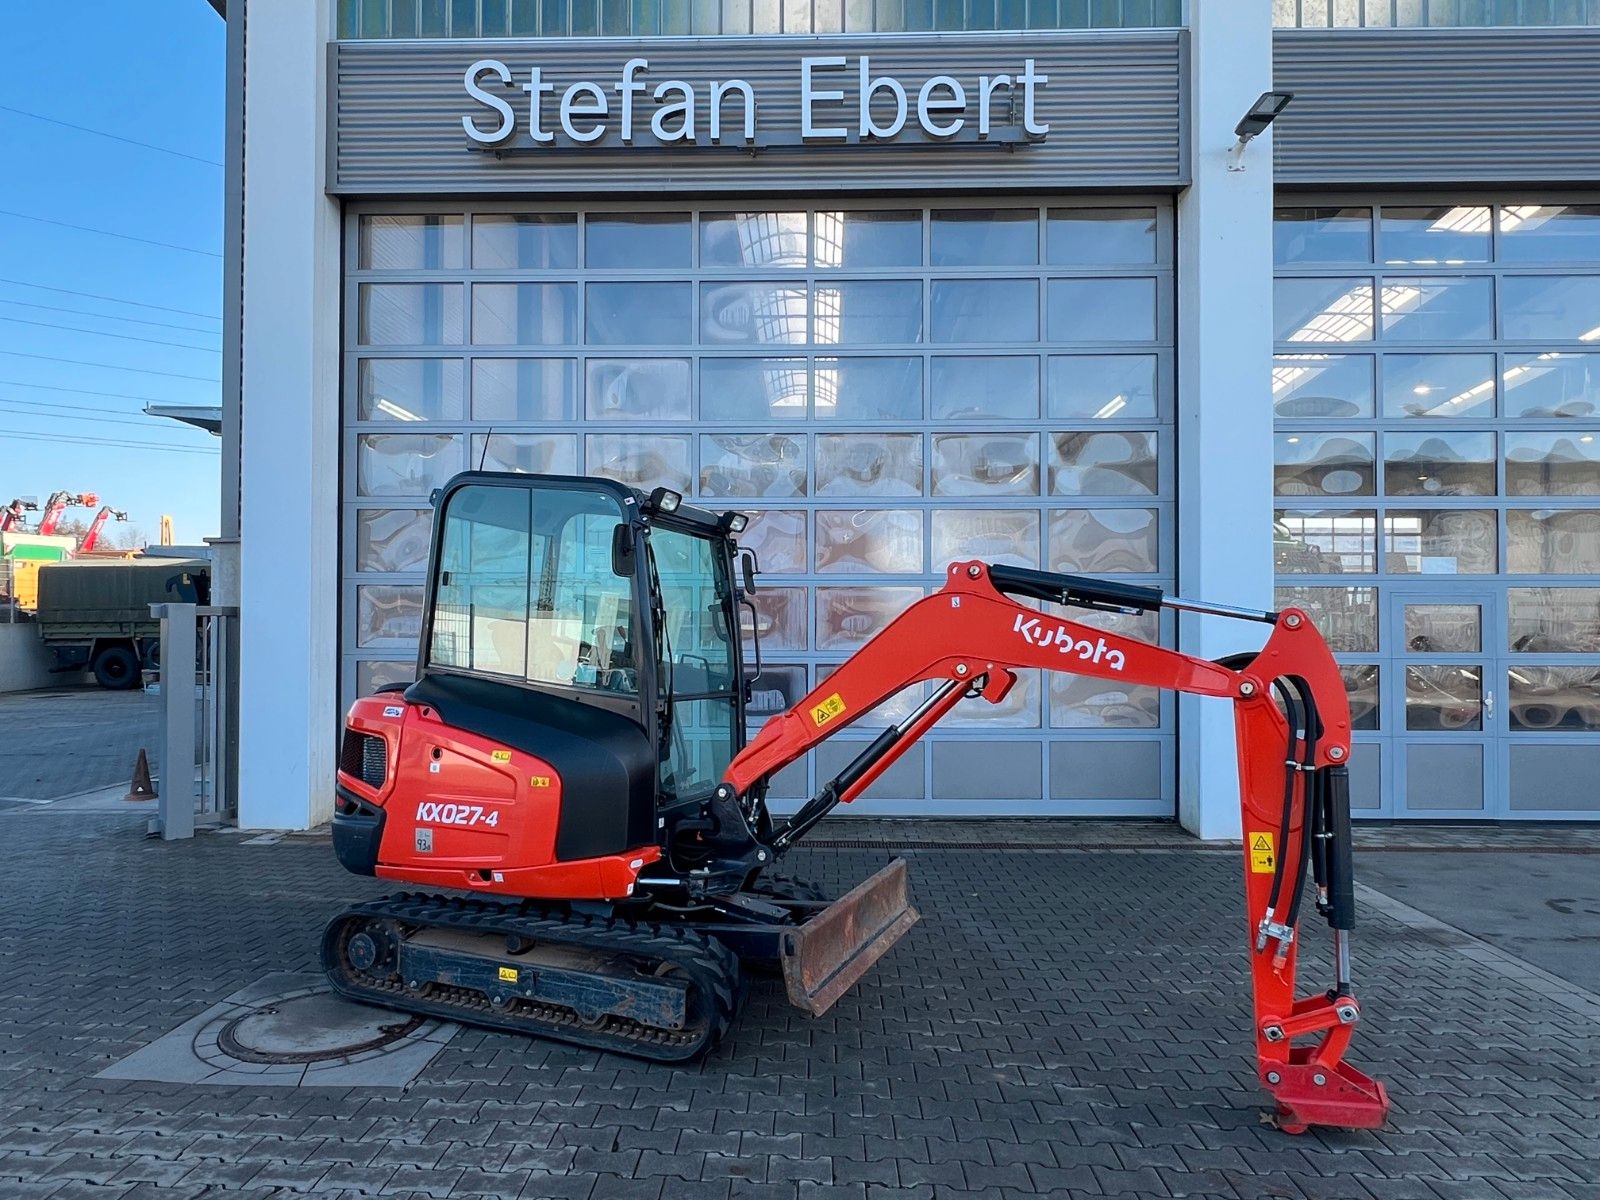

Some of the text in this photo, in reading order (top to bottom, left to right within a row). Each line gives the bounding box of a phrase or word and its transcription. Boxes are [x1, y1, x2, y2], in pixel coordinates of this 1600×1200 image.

[462, 56, 1049, 143] Stefan Ebert
[1013, 613, 1125, 671] Kubota
[415, 802, 499, 827] KX027-4
